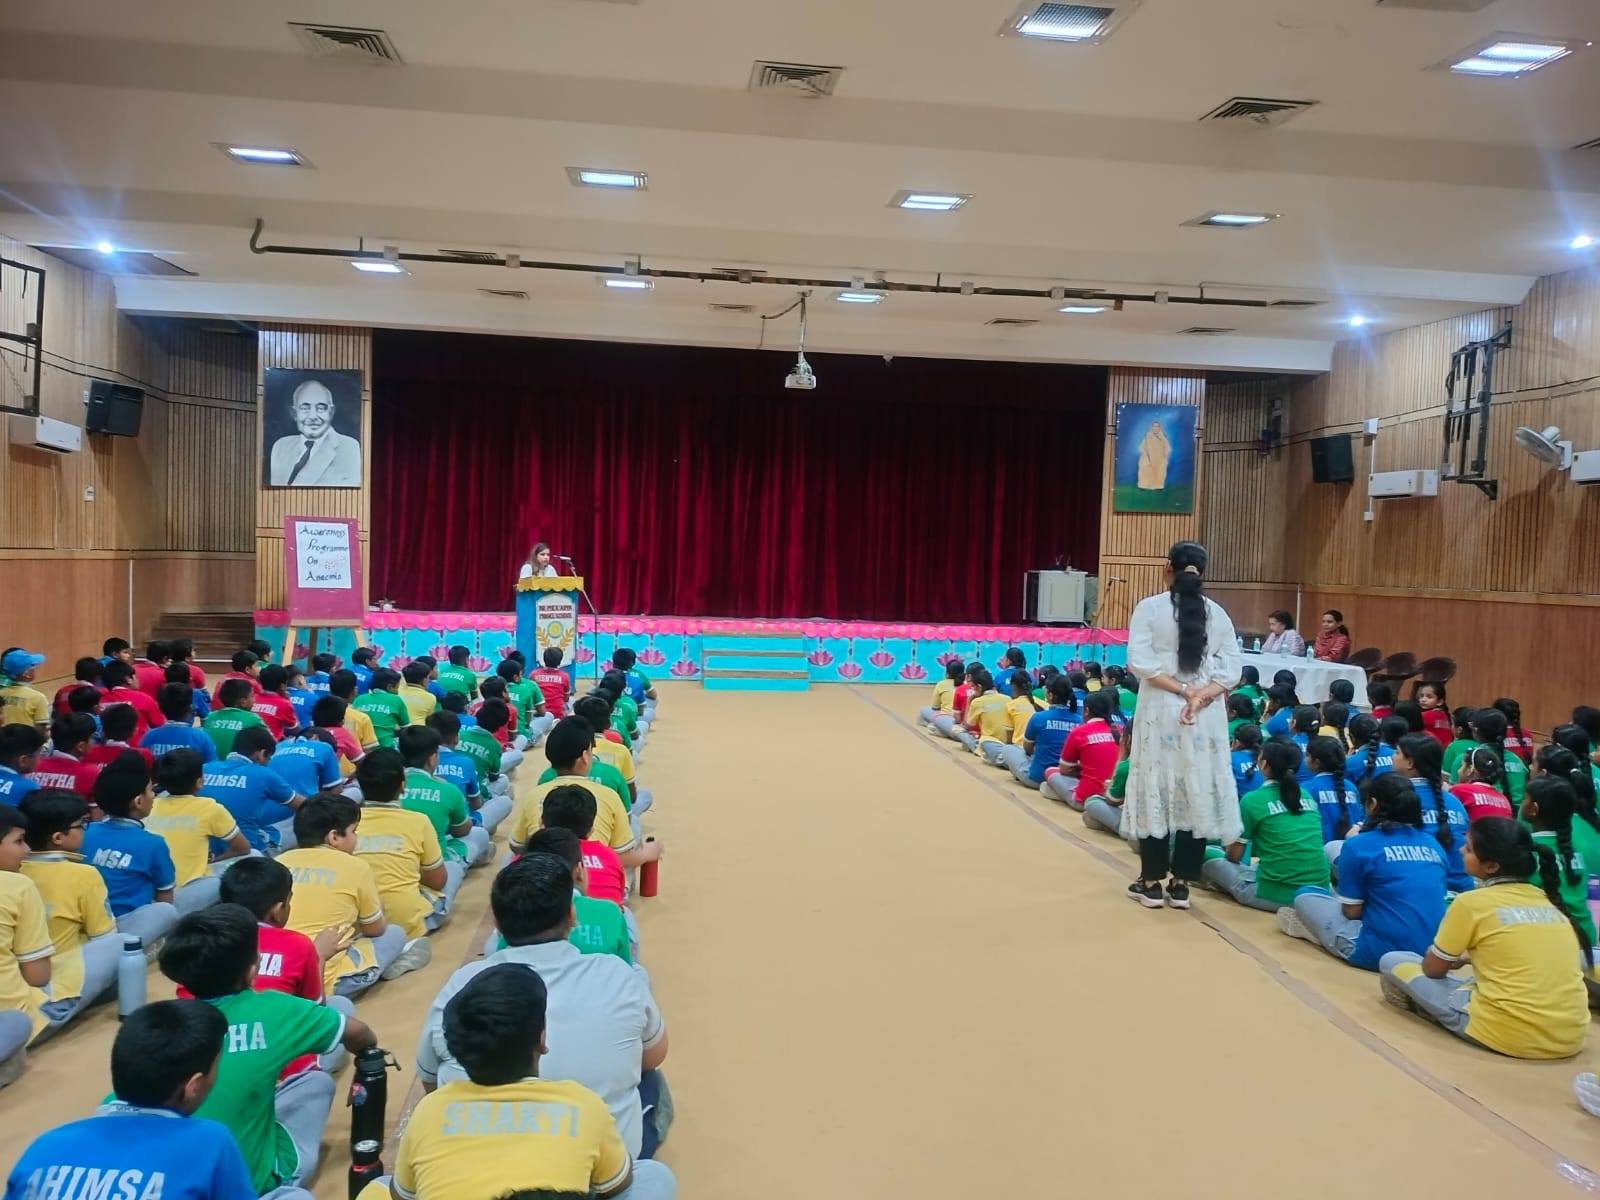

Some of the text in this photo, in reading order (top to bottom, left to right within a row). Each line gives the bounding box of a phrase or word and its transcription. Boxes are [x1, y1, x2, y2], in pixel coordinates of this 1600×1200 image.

[306, 556, 319, 565] On
[1383, 845, 1441, 863] AHIMSA
[224, 1021, 267, 1053] HA
[442, 1102, 580, 1138] SHAKTI
